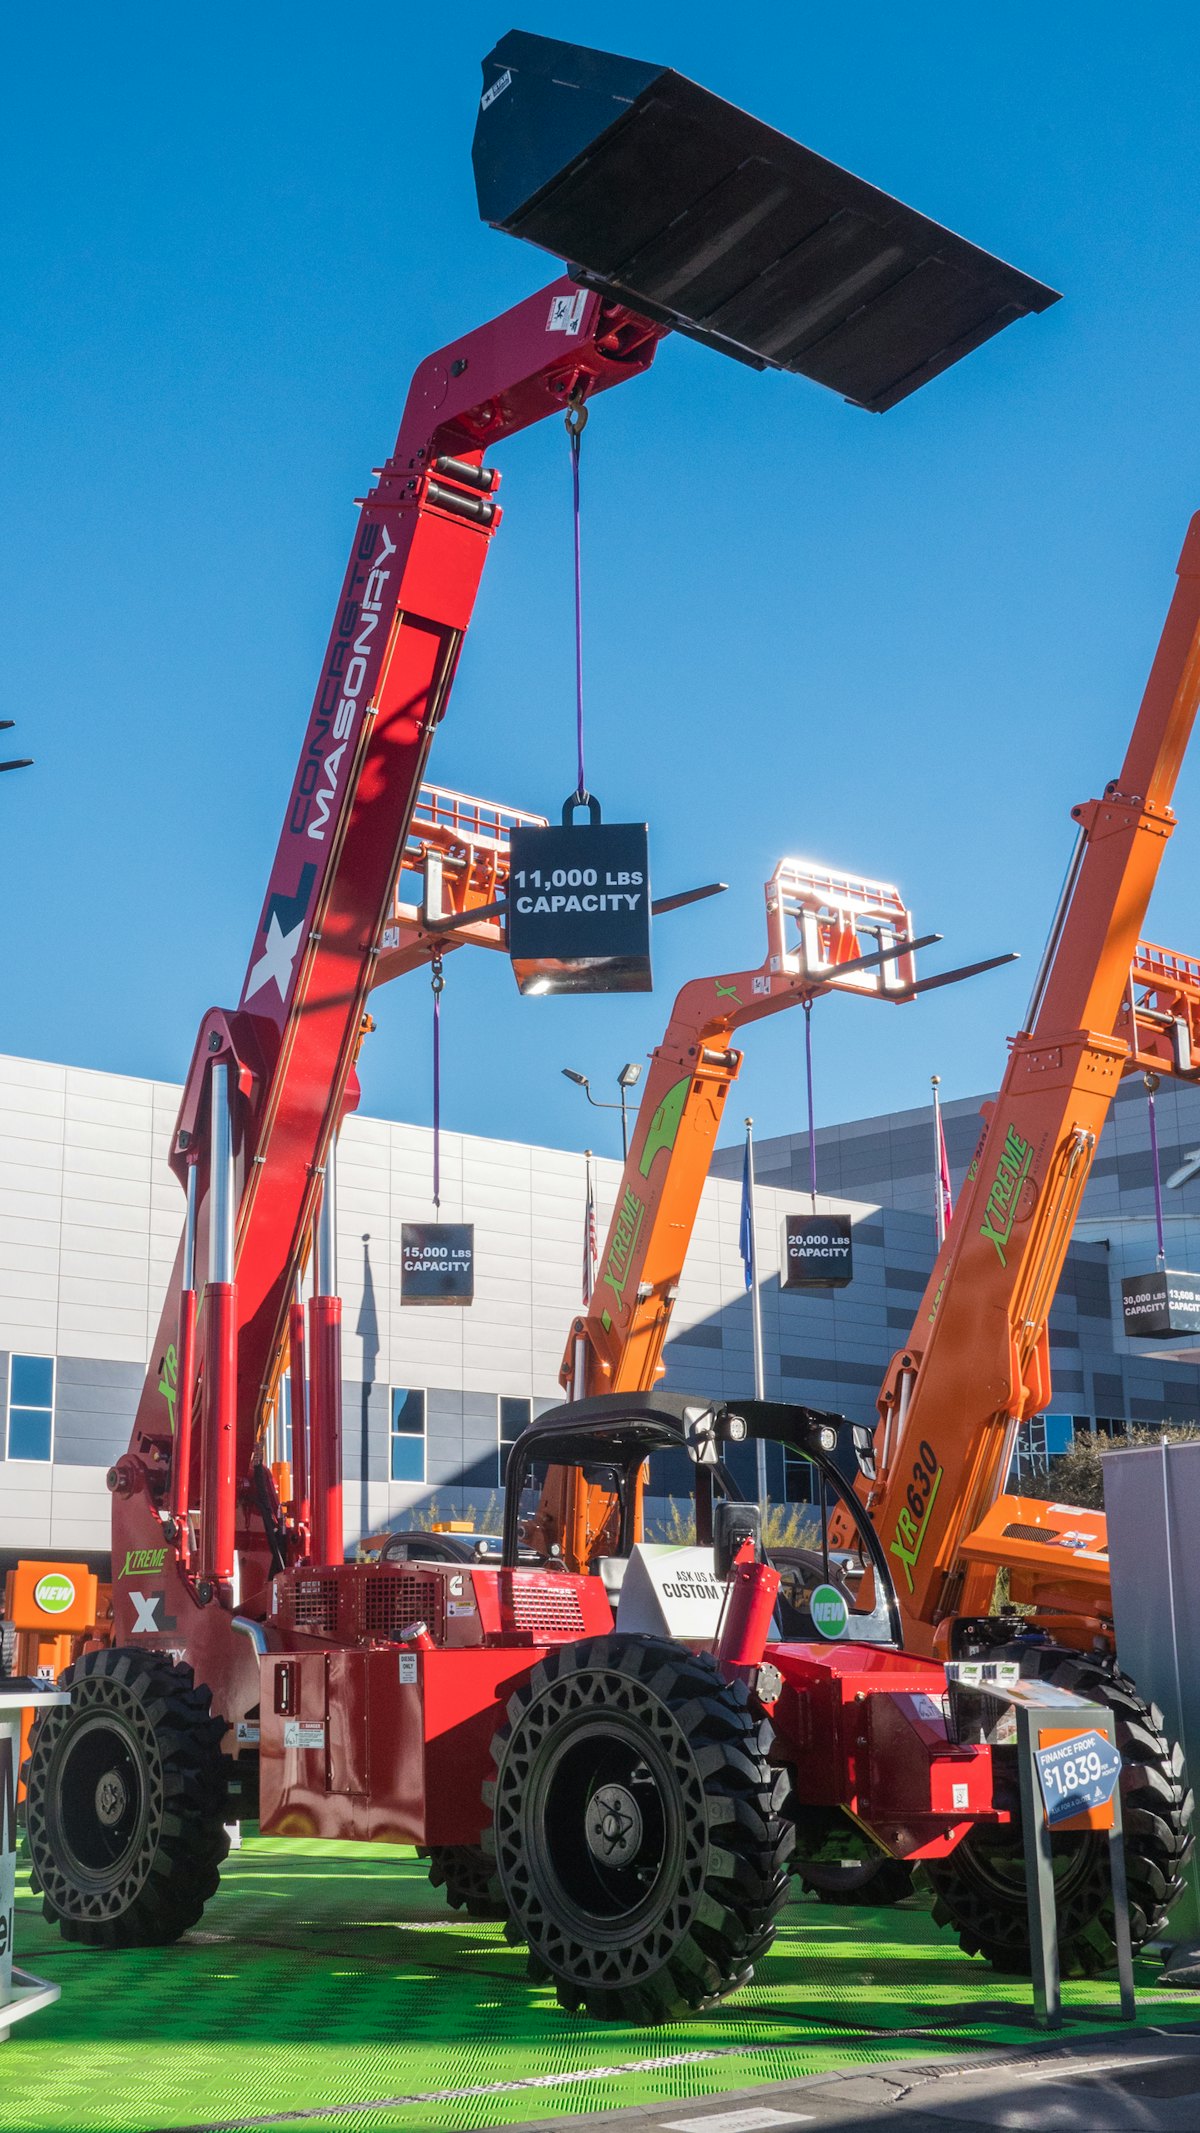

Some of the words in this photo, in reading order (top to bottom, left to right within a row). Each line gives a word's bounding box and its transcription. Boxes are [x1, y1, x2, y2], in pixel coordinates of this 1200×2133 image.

[290, 523, 379, 834] CONCRETE
[308, 525, 397, 841] MASONRY
[514, 868, 598, 891] 11,000
[605, 872, 644, 886] LBS
[516, 893, 641, 914] CAPACITY
[244, 862, 318, 1003] XL
[978, 1122, 1034, 1269] XTREME
[603, 1183, 645, 1313] XTREME
[788, 1235, 829, 1247] 20,000
[832, 1237, 850, 1245] LBS
[403, 1247, 448, 1259] 15,000
[452, 1250, 472, 1258] LBS
[790, 1248, 849, 1257] CAPACITY
[404, 1261, 471, 1271] CAPACITY
[1123, 1293, 1151, 1305] 30,000
[1153, 1292, 1166, 1300] LBS
[1125, 1302, 1166, 1316] CAPACITY
[1169, 1301, 1200, 1312] CAPACIT
[890, 1440, 943, 1594] XR630
[118, 1548, 168, 1580] XTREME
[676, 1571, 694, 1581] ASK
[694, 1572, 708, 1582] US
[40, 1586, 73, 1601] NEW
[662, 1583, 719, 1599] CUSTOM
[128, 1590, 177, 1633] XL
[814, 1603, 845, 1621] NEW
[1040, 1746, 1074, 1765] FINANCE
[1073, 1737, 1096, 1753] FROM:
[1043, 1752, 1101, 1797] $1,839
